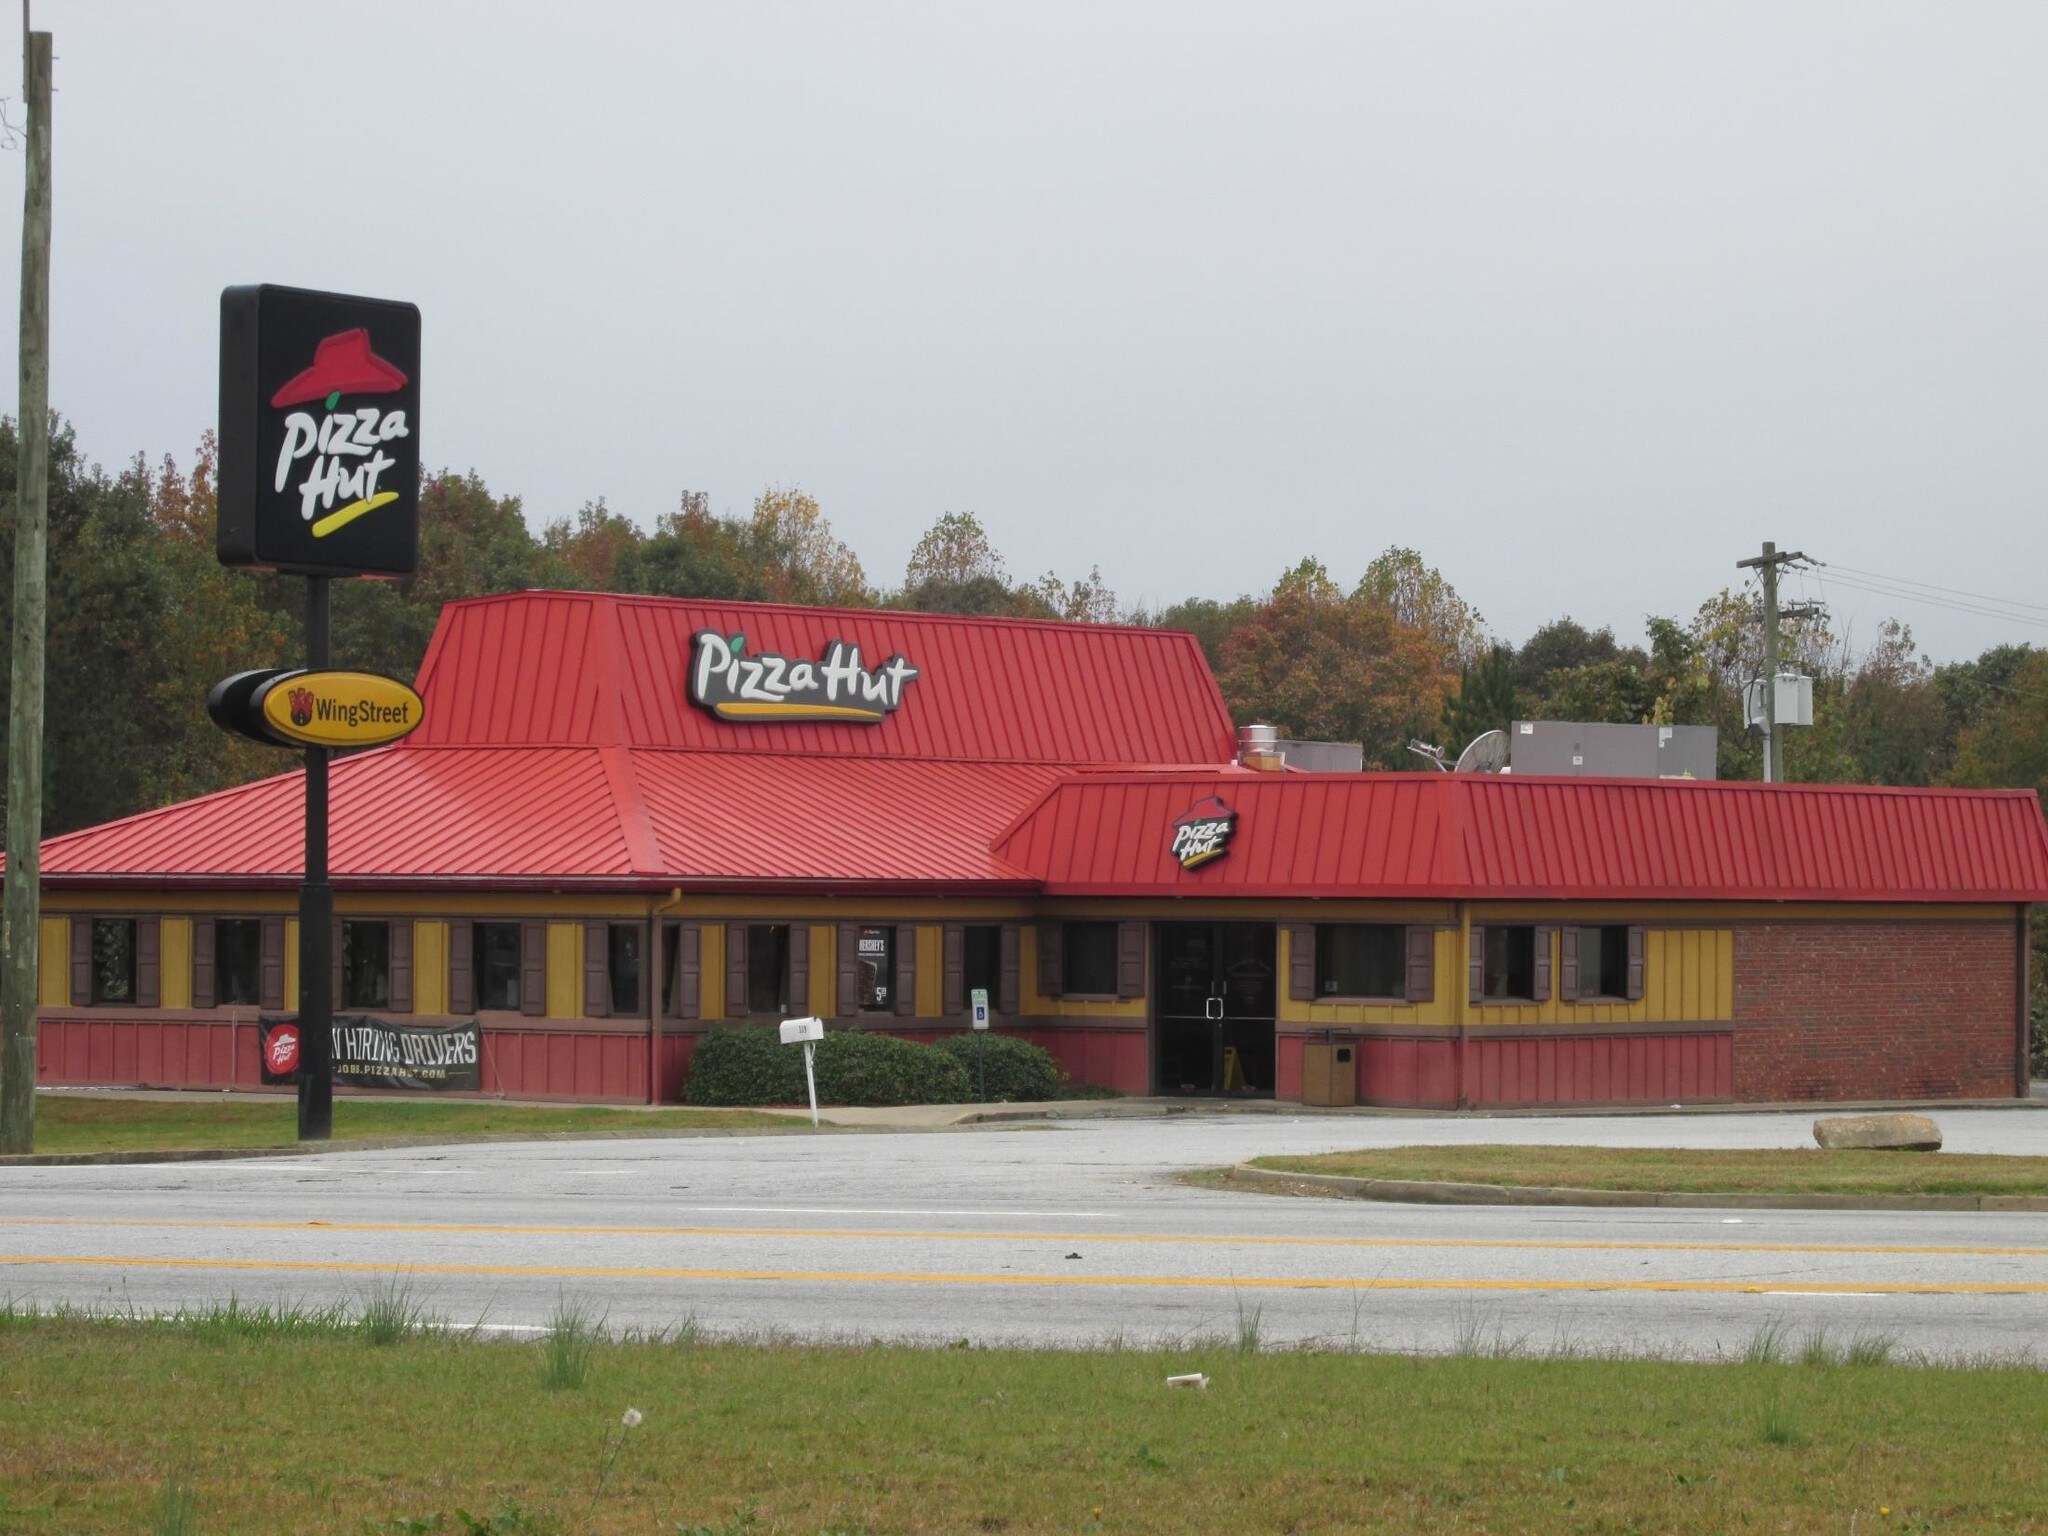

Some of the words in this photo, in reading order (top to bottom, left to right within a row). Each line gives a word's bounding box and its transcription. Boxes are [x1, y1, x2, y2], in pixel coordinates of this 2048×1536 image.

[275, 390, 409, 493] Pizza
[299, 450, 395, 521] Hut
[697, 633, 819, 702] Pizza
[821, 643, 918, 706] Hut
[315, 699, 409, 728] WingStreet
[1172, 819, 1230, 852] Pizza
[1180, 835, 1222, 861] Hut
[272, 1043, 296, 1060] Pizza
[344, 1027, 400, 1063] HIRING
[401, 1031, 476, 1065] DRIVERS
